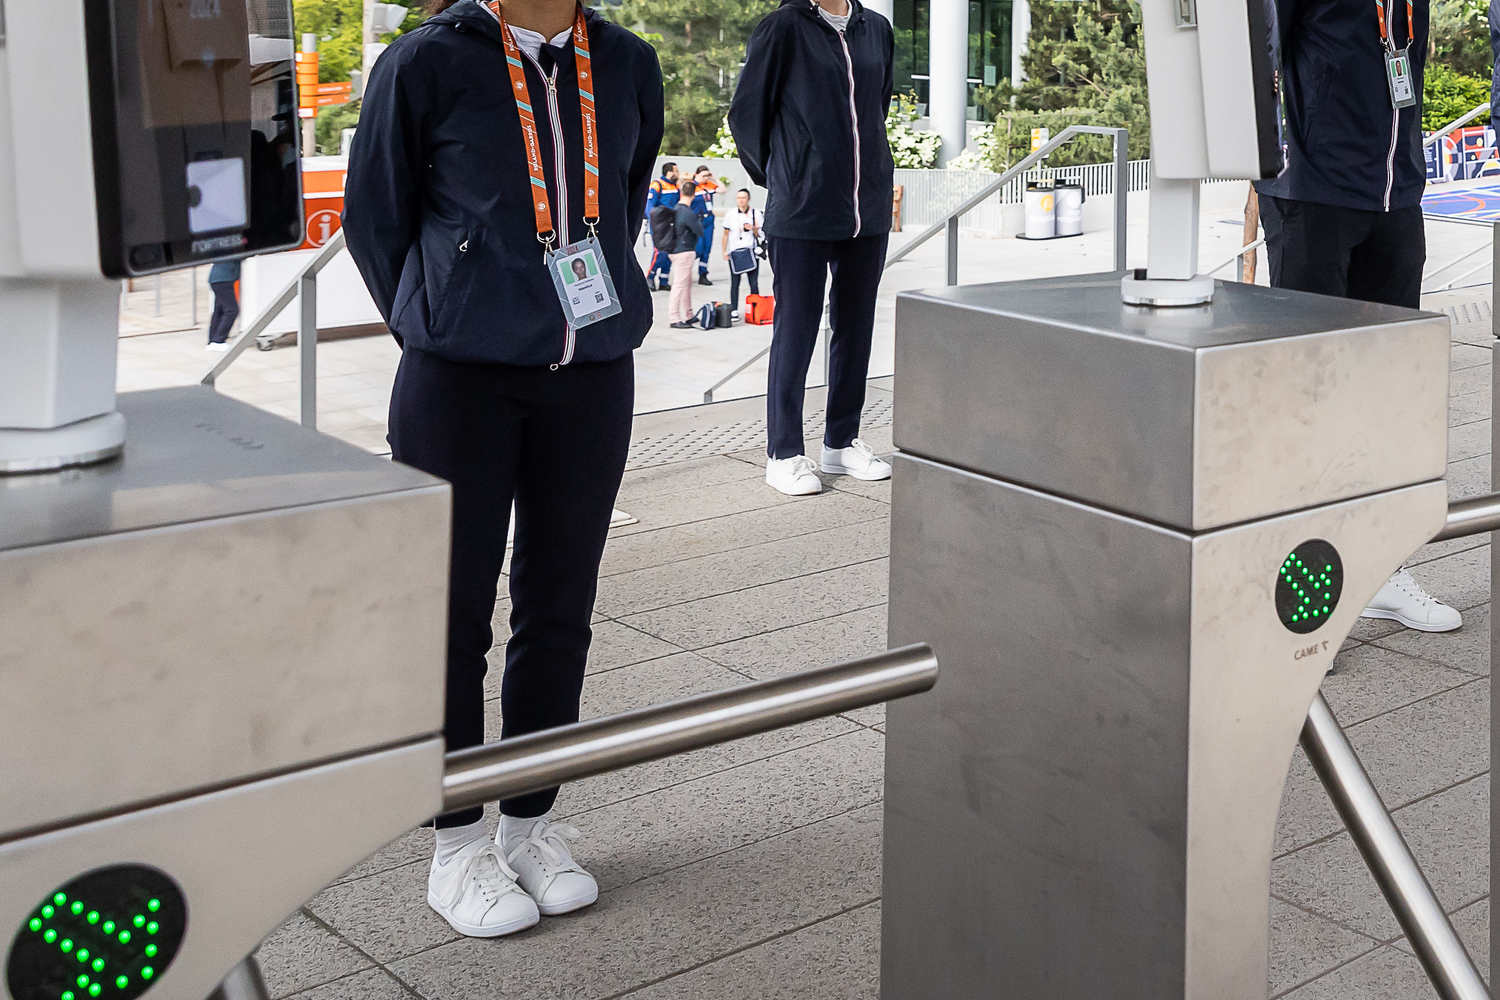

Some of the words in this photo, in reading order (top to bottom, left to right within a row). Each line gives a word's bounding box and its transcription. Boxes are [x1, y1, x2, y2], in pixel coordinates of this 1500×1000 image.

[526, 124, 539, 172] ROLAND-GARROS
[585, 112, 595, 158] ROLAND-GARROS
[1294, 644, 1318, 660] CAME
